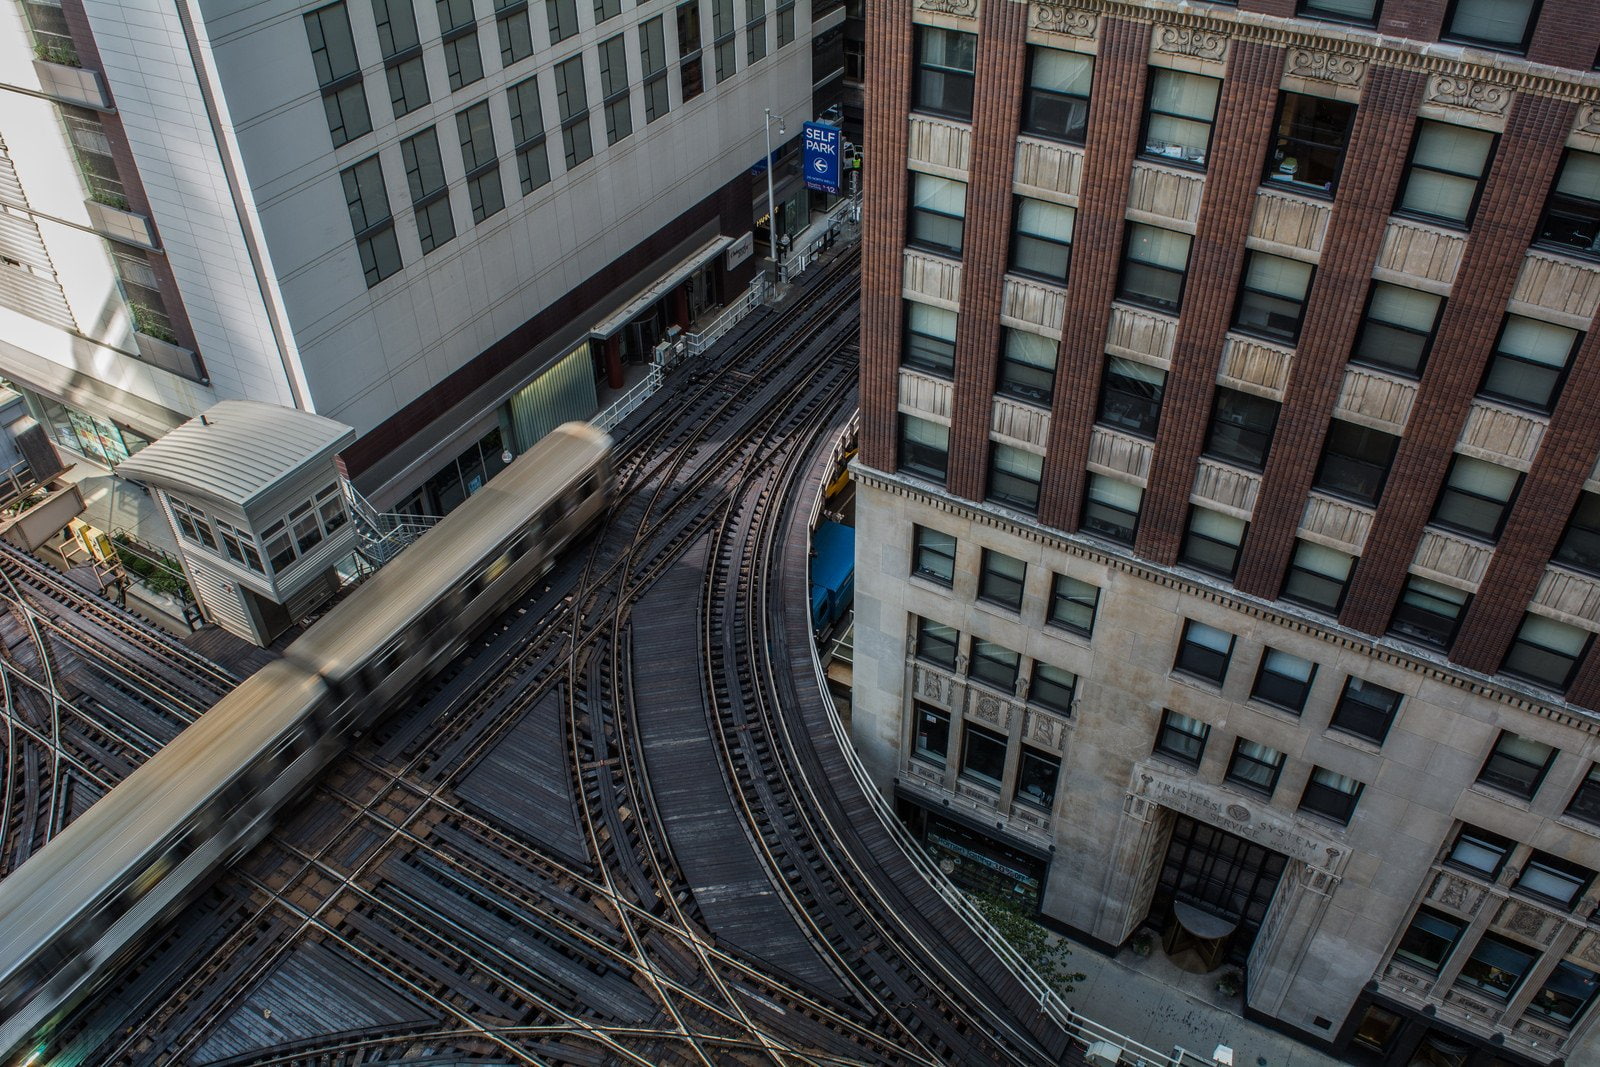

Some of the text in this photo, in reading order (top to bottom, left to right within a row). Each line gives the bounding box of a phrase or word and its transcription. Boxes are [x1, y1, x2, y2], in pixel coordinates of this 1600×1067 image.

[806, 128, 835, 142] SELF
[806, 140, 835, 155] PARK
[1157, 781, 1317, 850] TRUSTEES SYSTEM
[1210, 812, 1259, 838] SERVICE
